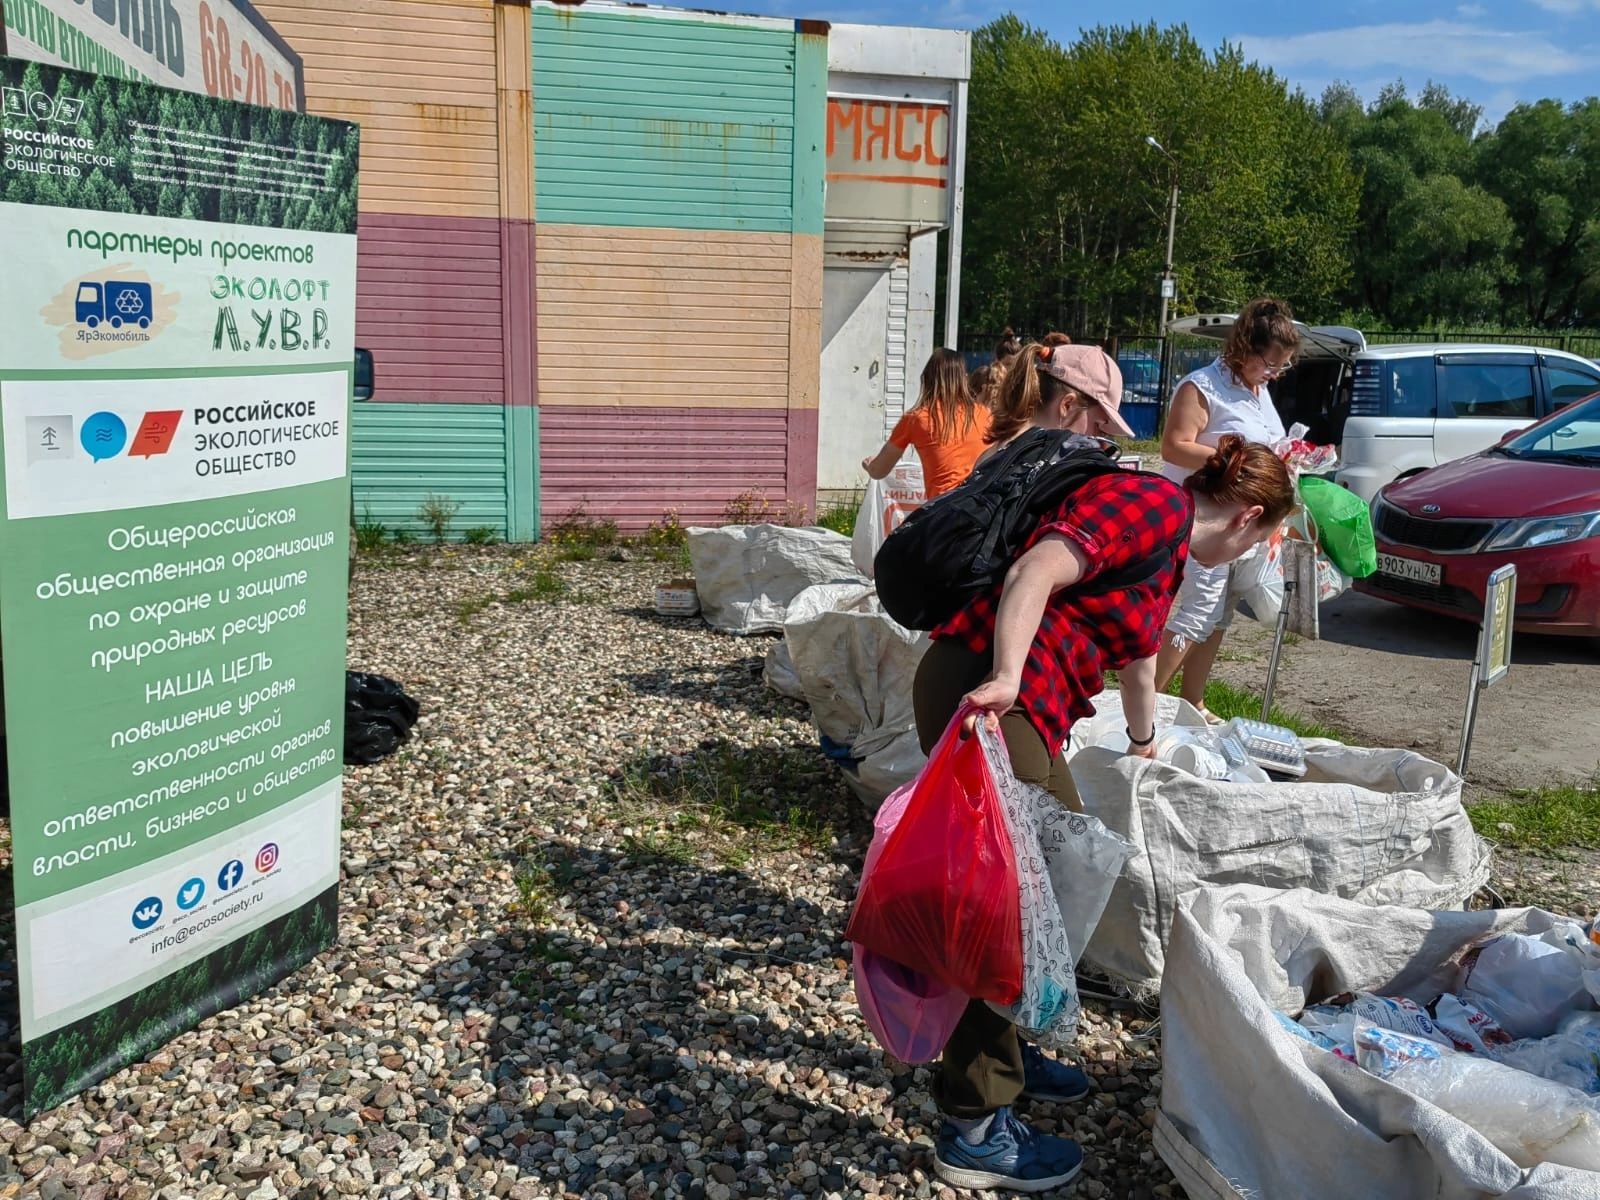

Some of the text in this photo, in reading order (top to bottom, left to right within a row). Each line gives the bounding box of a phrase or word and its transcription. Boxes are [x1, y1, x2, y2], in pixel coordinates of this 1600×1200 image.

[4, 128, 94, 150] РОССИЙСКОЕ
[5, 143, 116, 168] ЭКОЛОГИЧЕСКОЕ
[826, 98, 949, 166] МЯСО
[5, 158, 81, 178] ОБЩЕСТВО
[67, 228, 313, 266] партнеры проектов
[76, 330, 150, 342] ЯрЭкомобиль
[194, 400, 316, 425] РОССИЙСКОЕ
[194, 420, 339, 451] ЭКОЛОГИЧЕСКОЕ
[195, 450, 296, 476] ОБЩЕСТВО
[883, 490, 926, 500] АГНИТ
[108, 507, 296, 551] Общероссийская
[36, 530, 335, 600] общественная организация
[89, 569, 308, 631] по охране и защите
[91, 599, 307, 673] природных ресурсов
[145, 651, 273, 704] НАША ЦЕЛЬ
[111, 677, 296, 749] повышение уровня
[131, 708, 282, 777] экологической
[43, 719, 331, 837] ответственности органов
[33, 747, 336, 877] власти, бизнеса и общество
[151, 891, 263, 955] info@ecosociety.ru
